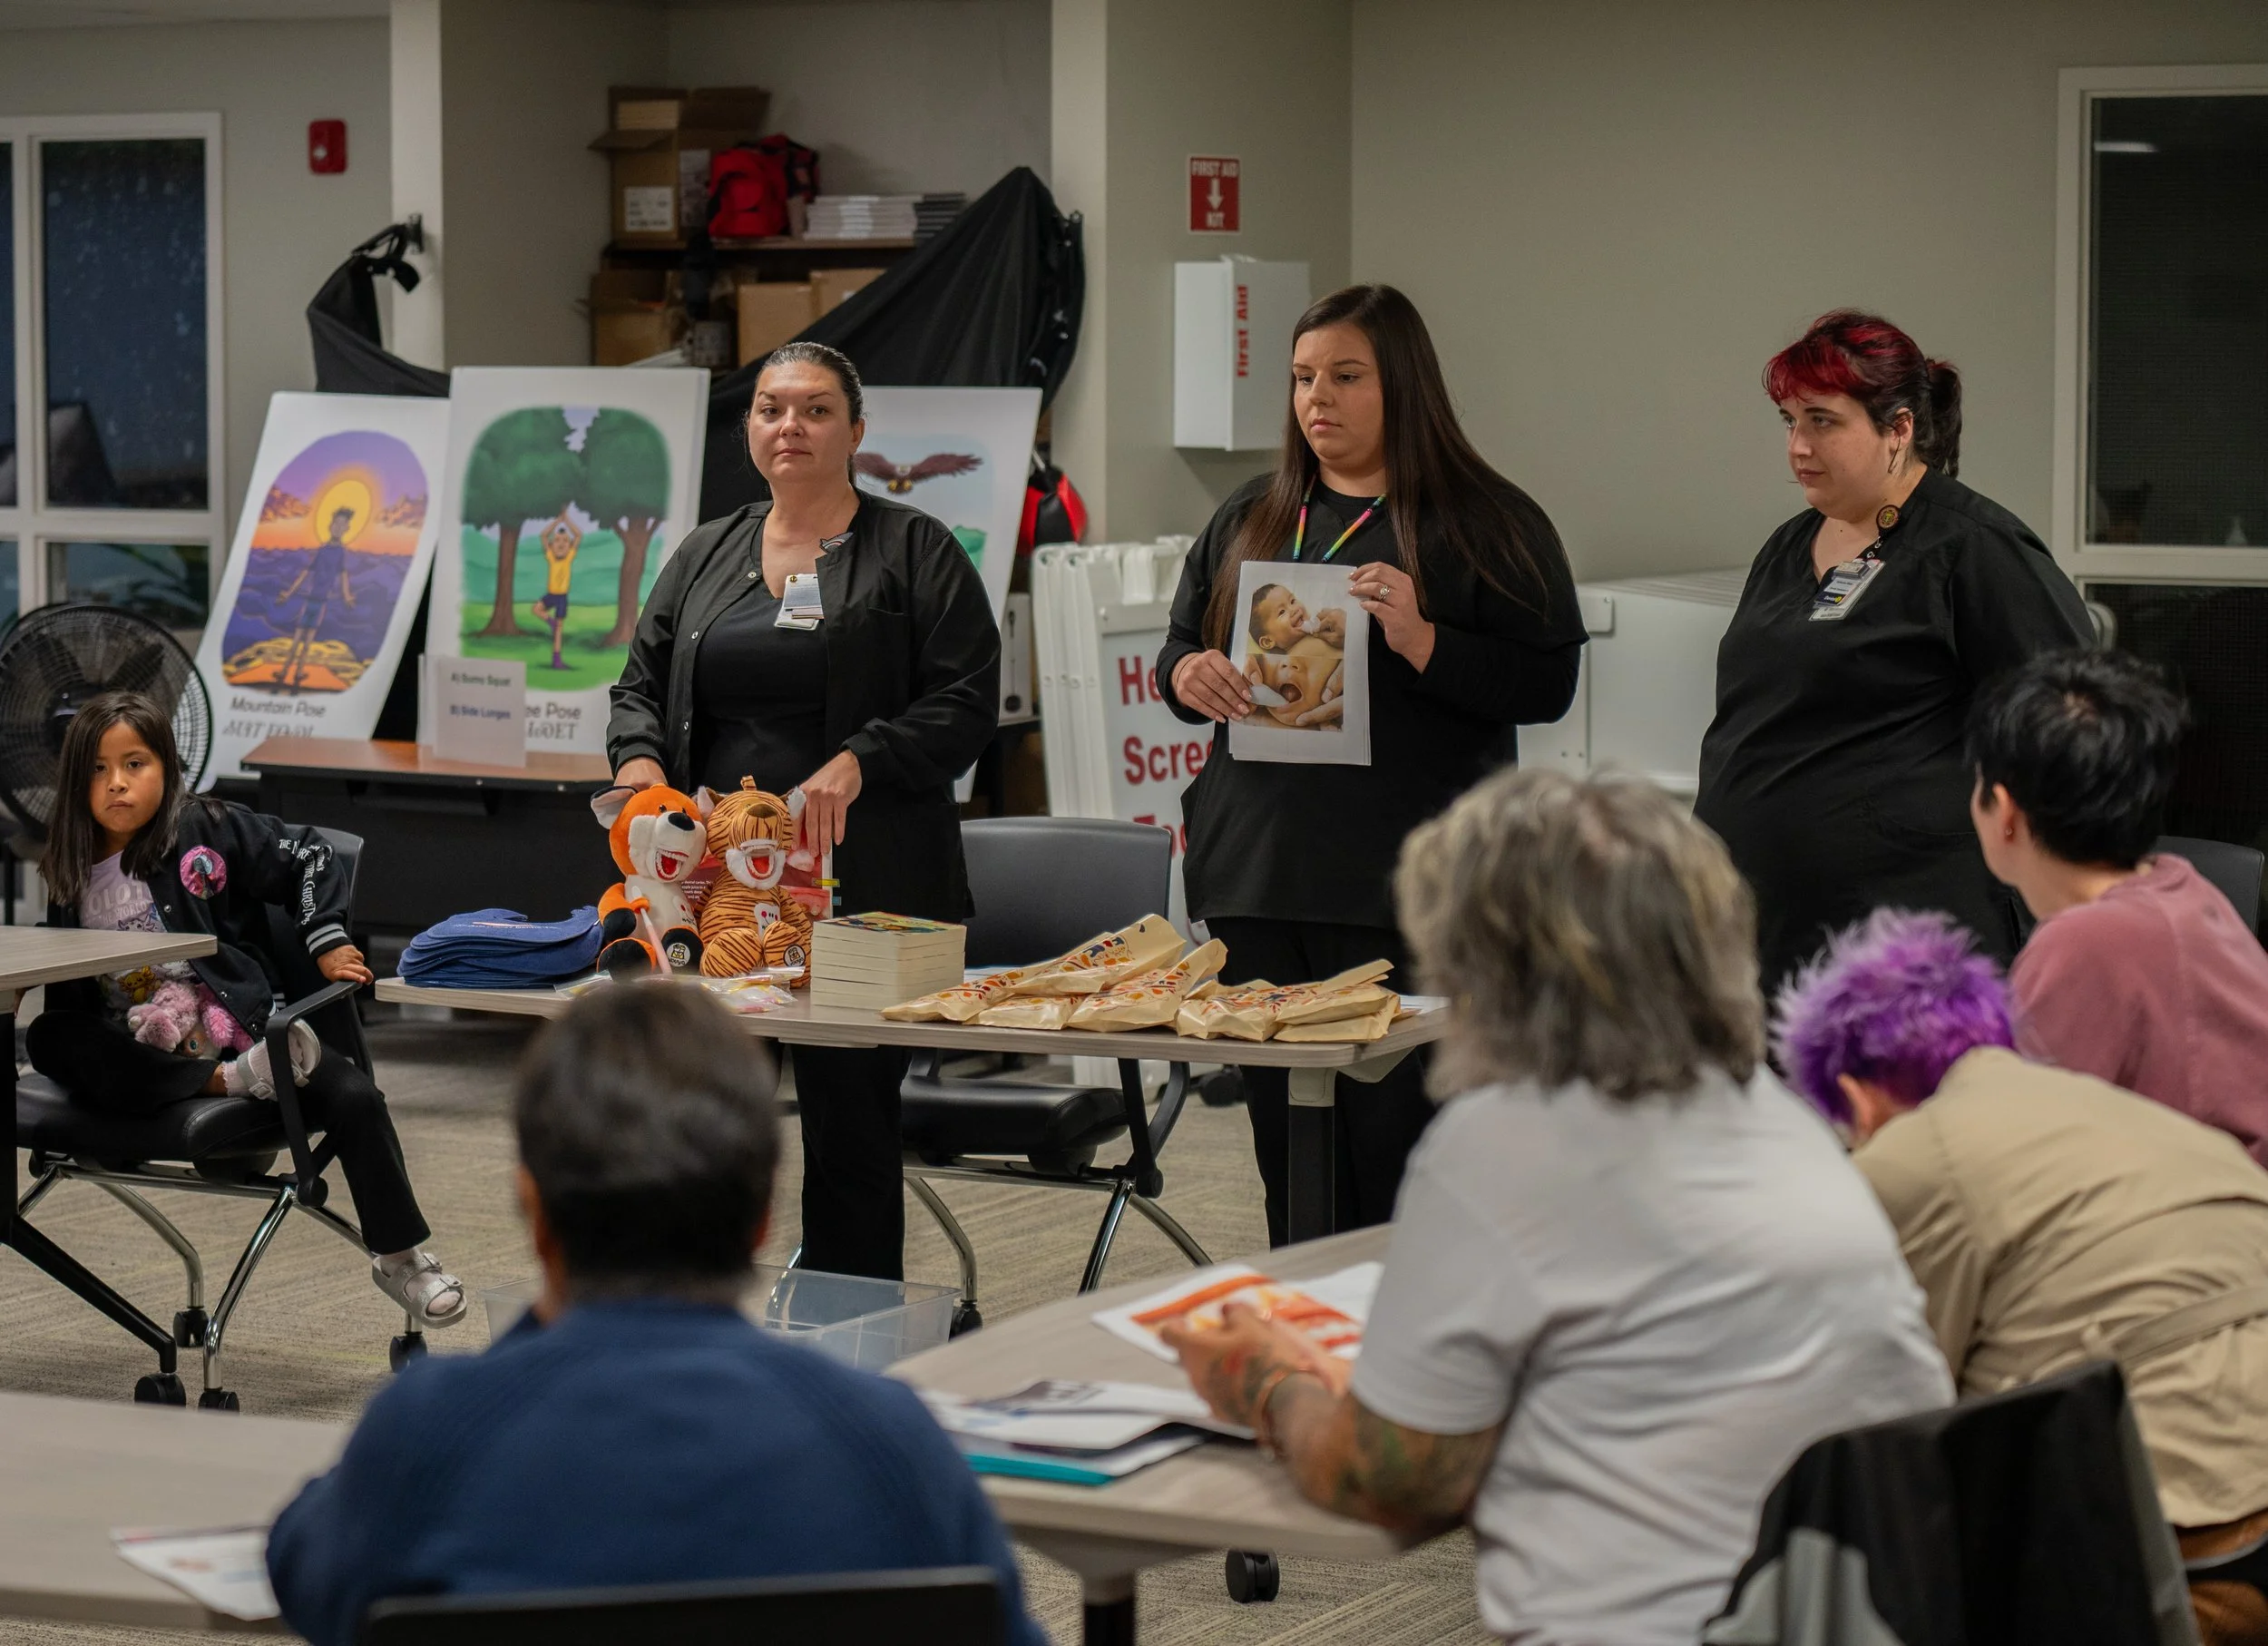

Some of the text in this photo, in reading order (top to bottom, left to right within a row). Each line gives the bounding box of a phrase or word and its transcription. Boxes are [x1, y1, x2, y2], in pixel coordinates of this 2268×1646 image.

[1191, 160, 1239, 177] FIRST AID
[1207, 211, 1225, 227] KIT
[1237, 285, 1248, 377] First Aid
[230, 696, 327, 718] Mountain Pose
[546, 701, 582, 720] Pose
[279, 838, 291, 849] THE
